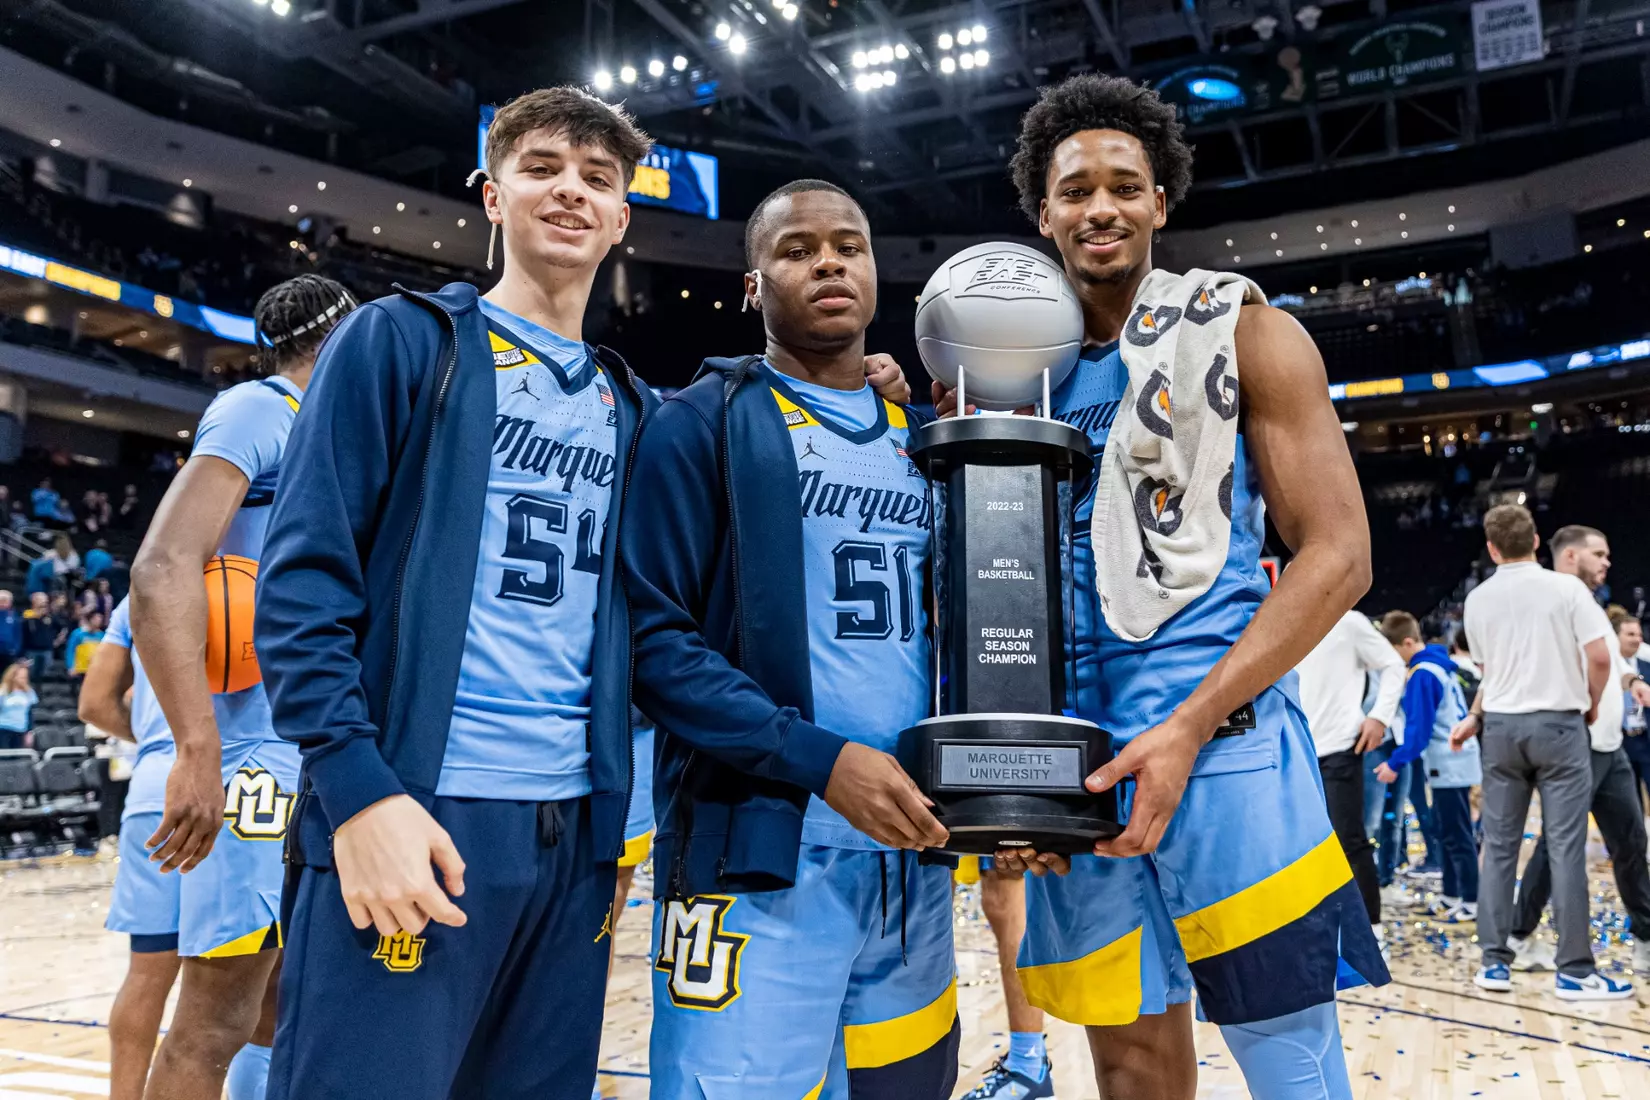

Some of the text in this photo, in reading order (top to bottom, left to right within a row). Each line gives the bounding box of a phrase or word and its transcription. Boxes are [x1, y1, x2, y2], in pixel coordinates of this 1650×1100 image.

[1478, 15, 1535, 35] CHAMPIONS
[1347, 66, 1385, 87] WORLD
[1389, 52, 1455, 77] CHAMPIONS
[970, 269, 1048, 283] EAST
[990, 285, 1041, 294] CONFERENCE
[986, 501, 1024, 511] 2022-23
[992, 558, 1020, 568] MEN'S
[977, 570, 1035, 580] BASKETBALL
[831, 540, 915, 642] 51
[981, 627, 1034, 639] REGULAR
[985, 640, 1030, 651] SEASON
[978, 653, 1037, 665] CHAMPION
[967, 752, 1052, 766] MARQUETTE
[969, 767, 1051, 780] UNIVERSITY
[223, 767, 297, 841] MU
[372, 927, 426, 972] MU
[655, 894, 752, 1012] MU
